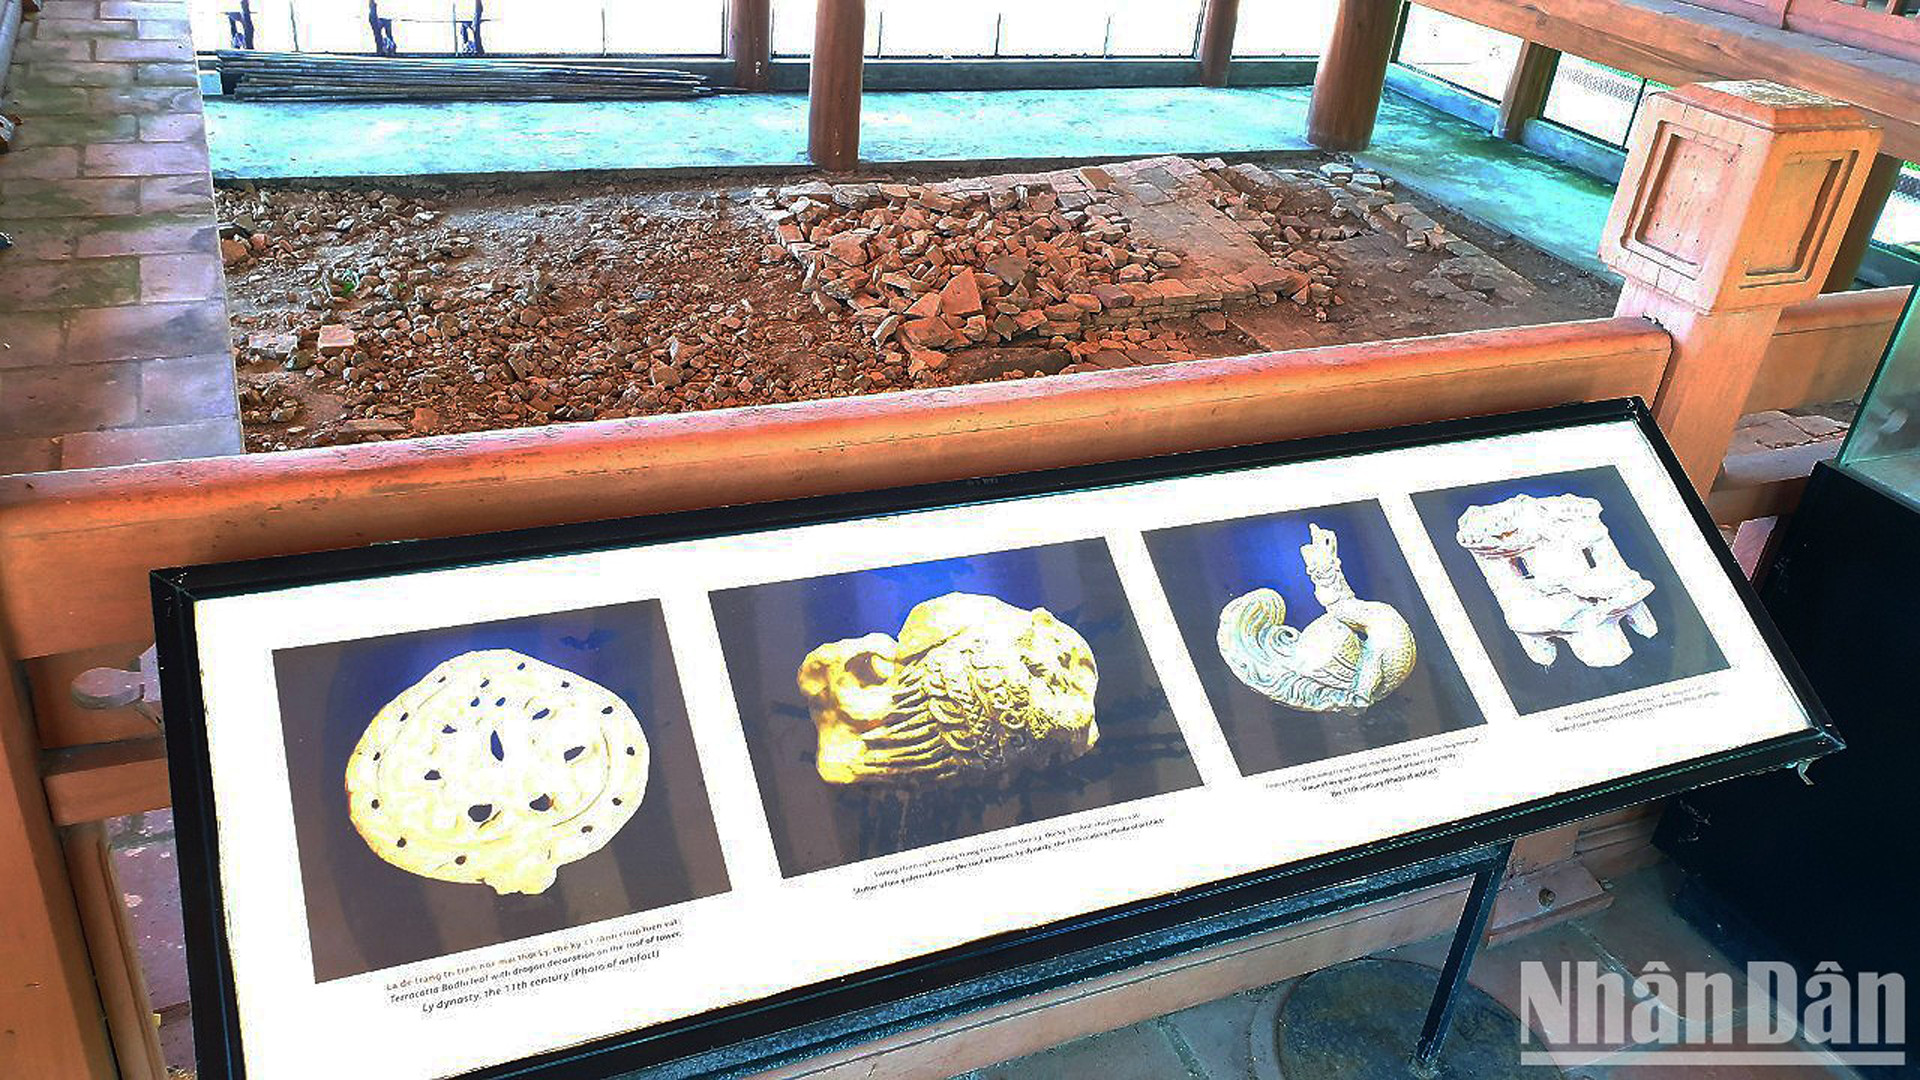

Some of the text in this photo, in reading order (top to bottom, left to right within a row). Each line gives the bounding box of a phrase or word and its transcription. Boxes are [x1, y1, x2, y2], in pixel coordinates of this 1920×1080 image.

[484, 987, 501, 999] the
[529, 971, 569, 988] century
[606, 957, 617, 969] of
